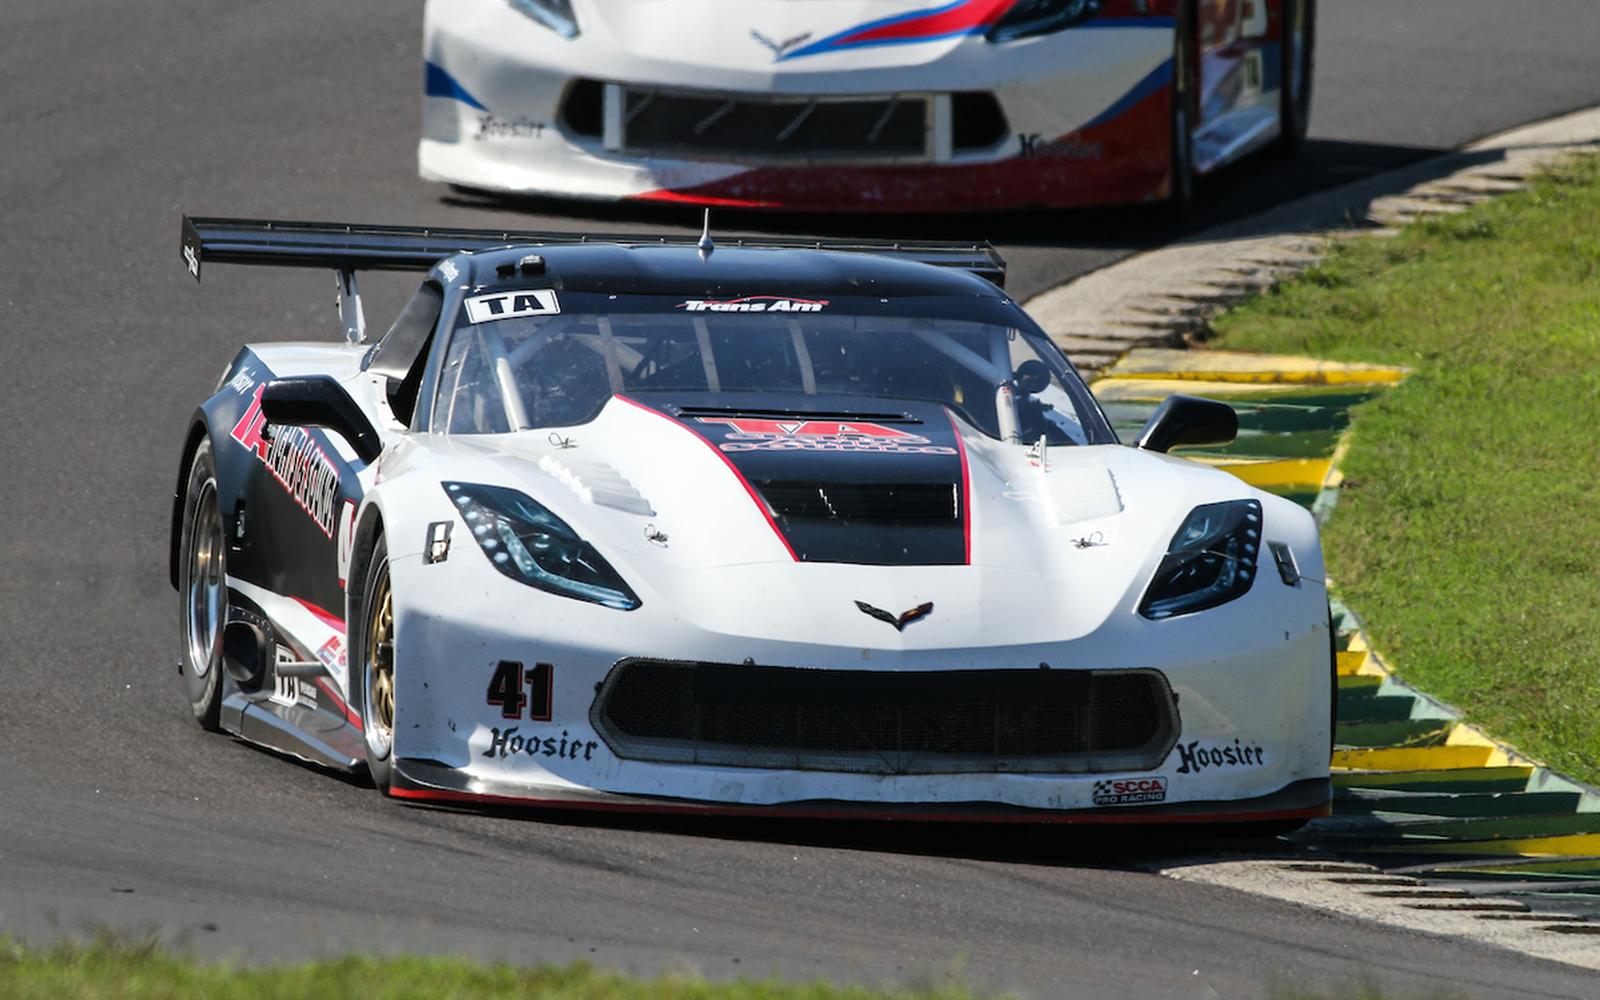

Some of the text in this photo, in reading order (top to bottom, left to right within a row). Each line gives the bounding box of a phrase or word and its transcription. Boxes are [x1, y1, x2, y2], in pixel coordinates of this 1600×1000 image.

[480, 294, 544, 314] TA
[685, 299, 823, 314] Trans Am
[486, 659, 554, 722] 41
[482, 726, 598, 761] Hoosier
[1176, 738, 1264, 774] Hoosier
[1113, 780, 1163, 794] SCCA
[1095, 792, 1164, 804] PRO RACING
